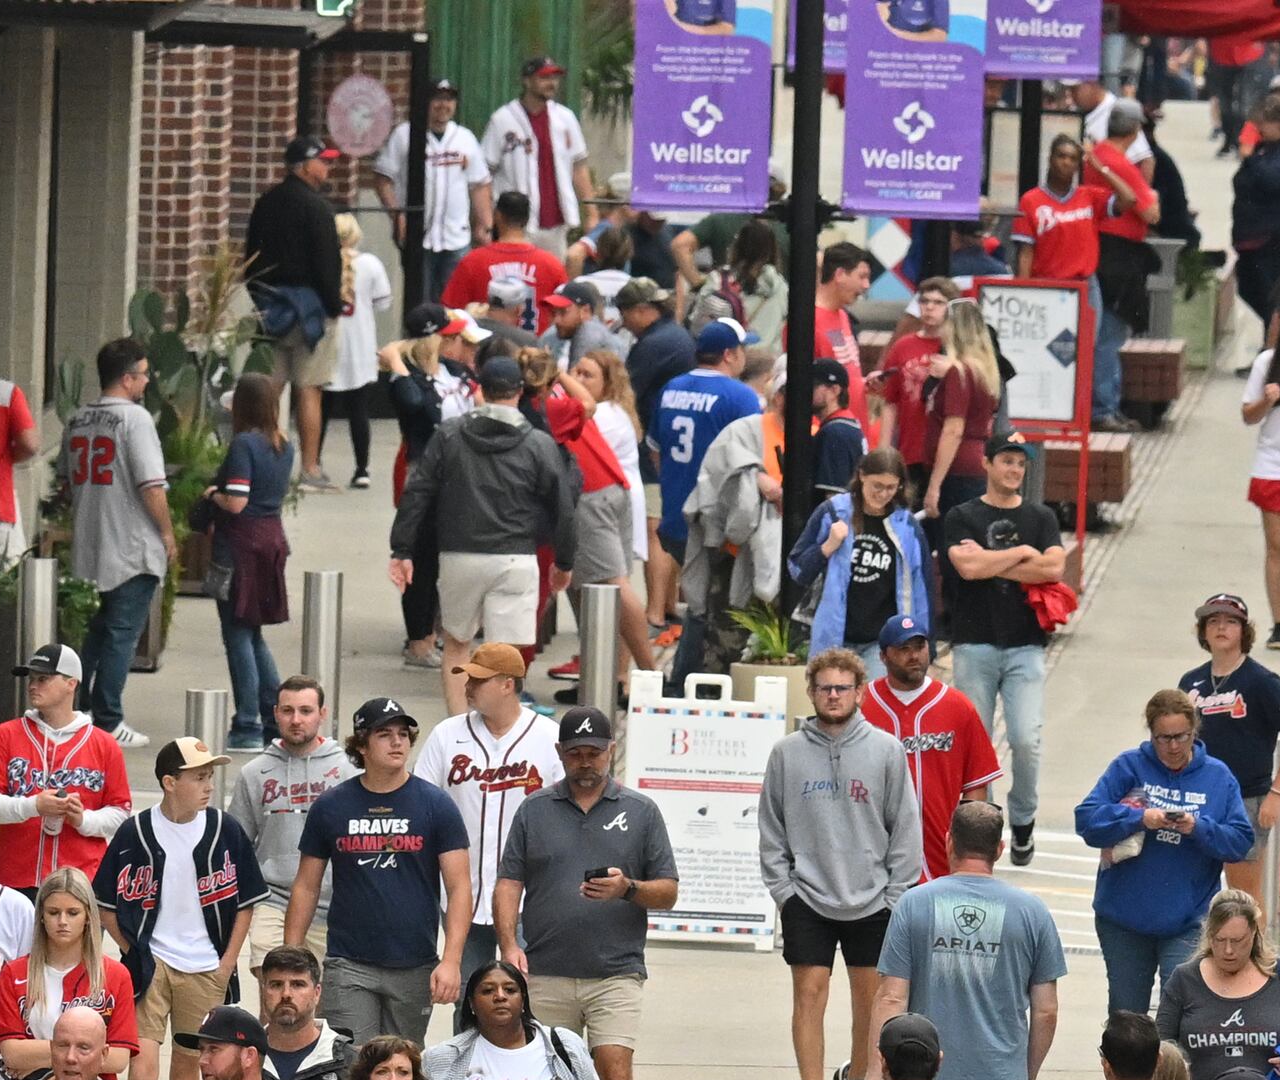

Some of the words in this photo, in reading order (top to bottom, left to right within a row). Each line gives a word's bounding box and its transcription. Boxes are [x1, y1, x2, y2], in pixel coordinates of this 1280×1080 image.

[996, 17, 1085, 39] Wellstar
[651, 142, 752, 165] Wellstar
[861, 148, 963, 172] Wellstar
[660, 389, 719, 413] MURPHY
[671, 415, 696, 464] 3
[70, 436, 117, 486] 32
[861, 550, 892, 570] BAR
[574, 717, 594, 735] A
[7, 757, 106, 798] Braves
[448, 754, 529, 787] Braves
[348, 818, 410, 836] BRAVES
[603, 811, 630, 833] A
[380, 854, 398, 869] A
[932, 936, 1001, 954] ARIAT
[1220, 1008, 1246, 1028] A
[1187, 1032, 1278, 1049] CHAMPIONS
